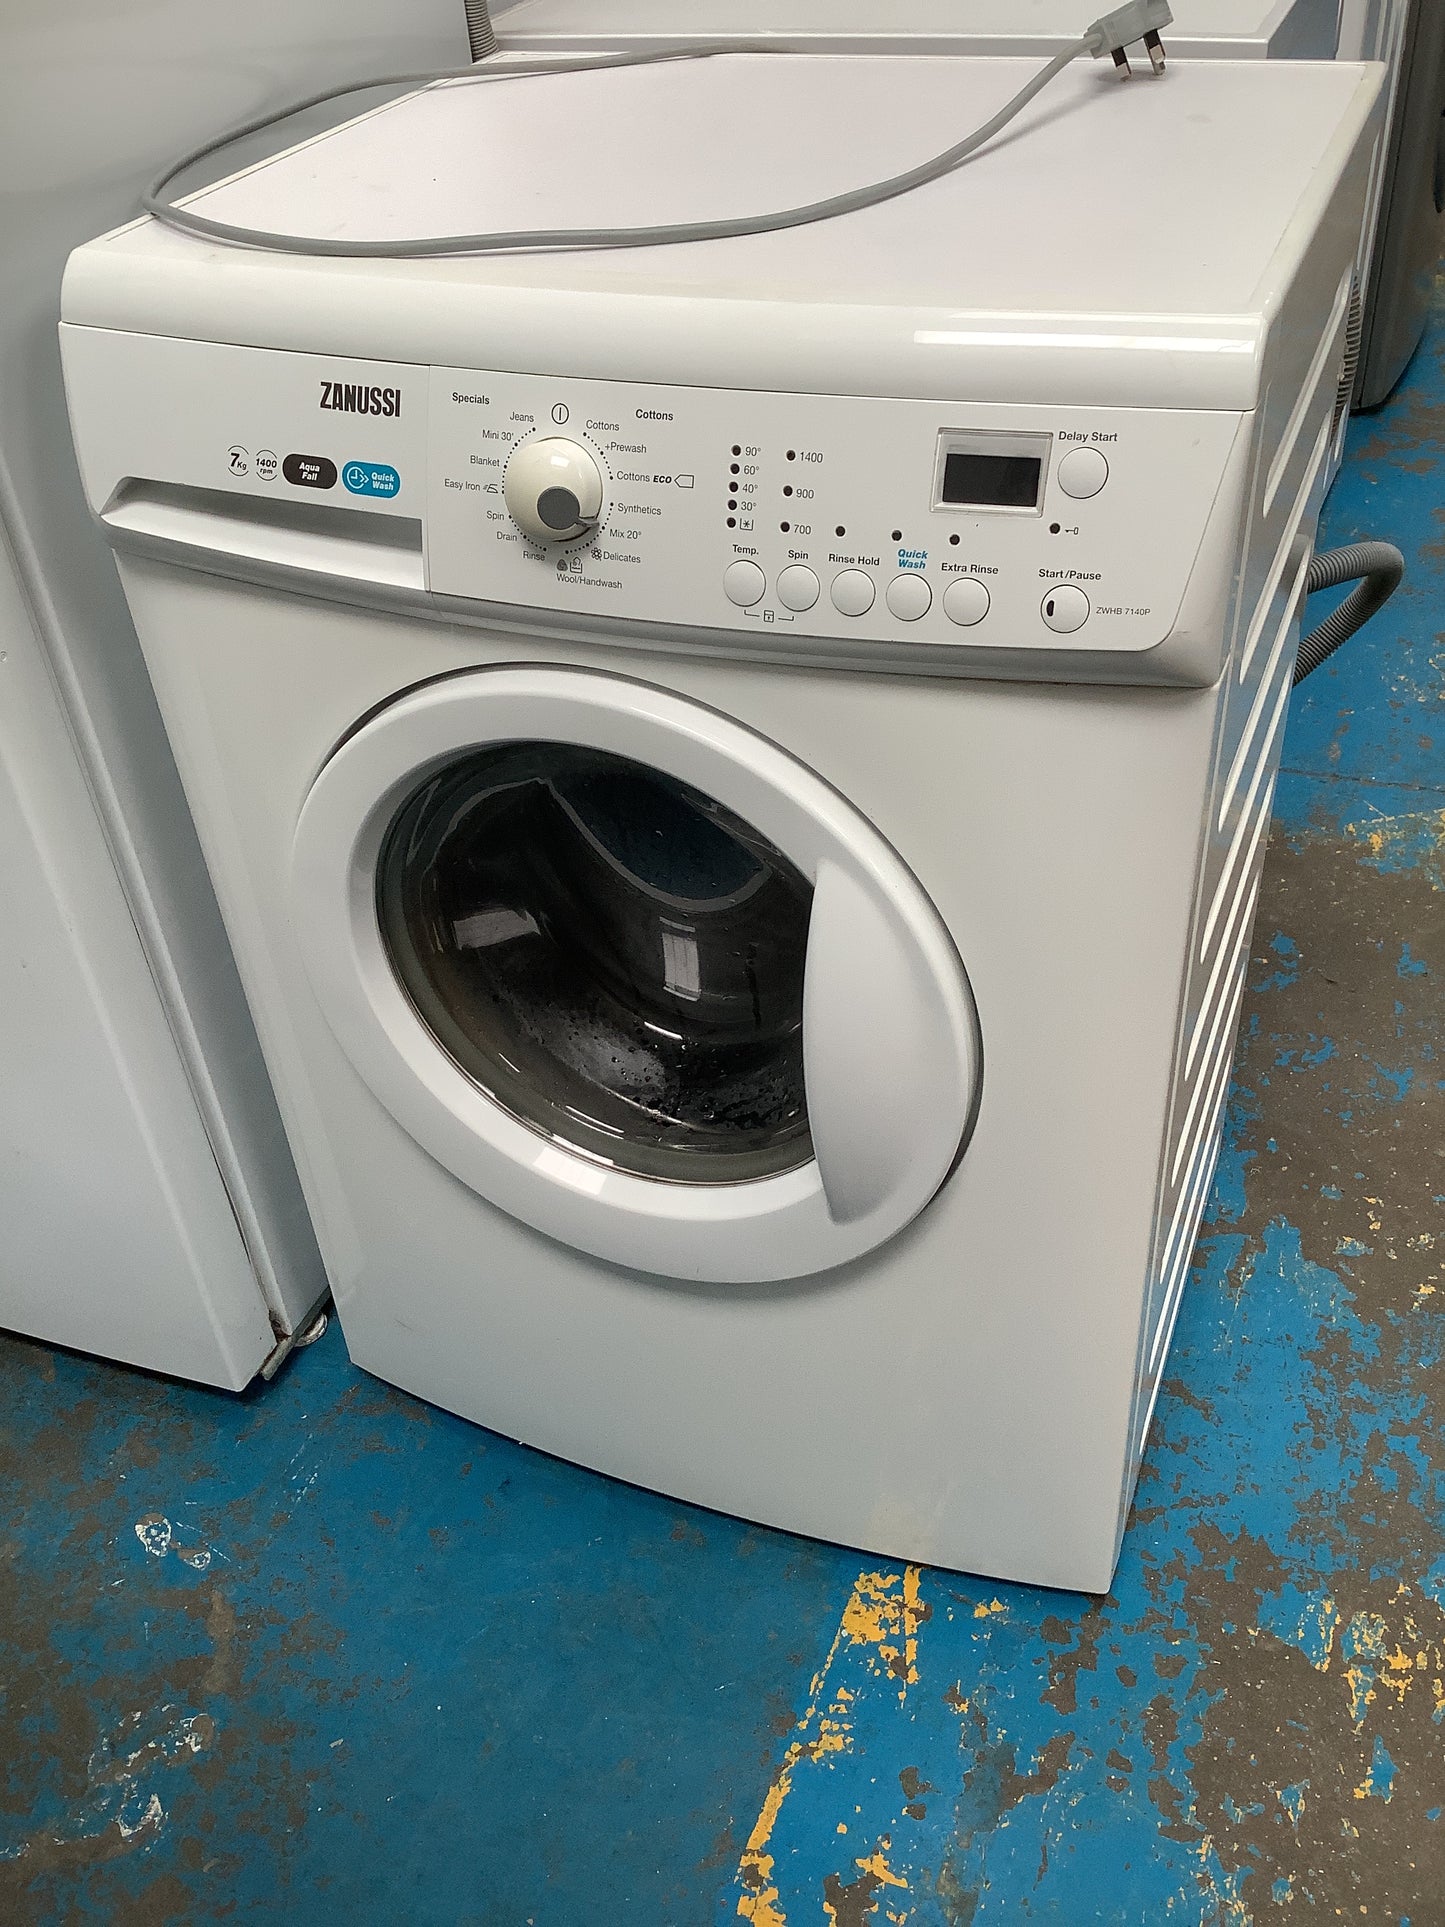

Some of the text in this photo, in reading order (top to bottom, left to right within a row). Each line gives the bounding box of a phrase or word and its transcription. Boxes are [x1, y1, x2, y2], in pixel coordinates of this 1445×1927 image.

[320, 381, 401, 417] ZANUSSI
[452, 392, 490, 405] Specials
[509, 411, 535, 422] Jeans
[635, 408, 674, 421] Cottons
[585, 420, 620, 431] Cottons
[482, 429, 499, 440] Mini
[1058, 431, 1118, 443] Delay Start
[255, 457, 278, 469] 1400
[470, 454, 500, 467] Blanket
[799, 451, 824, 463] 1400
[259, 467, 273, 475] rpm
[298, 461, 320, 473] Aqua
[301, 471, 318, 481] Fall
[371, 471, 395, 482] Quick
[616, 470, 672, 484] Cottons ECO
[372, 480, 394, 491] Wash
[444, 478, 481, 491] Easy Iron
[796, 488, 815, 499] 900
[617, 502, 662, 516] Synthetics
[486, 510, 505, 521] Spin
[609, 529, 624, 538] Mix
[793, 524, 812, 535] 700
[496, 531, 518, 541] Drain
[522, 550, 546, 561] Rinse
[732, 543, 759, 556] Temp.
[788, 549, 809, 560] Spin
[897, 548, 928, 560] Quick
[603, 551, 641, 563] Delicates
[828, 553, 880, 566] Rinse Hold
[898, 559, 926, 569] Wash
[941, 562, 999, 575] Extra Rinse
[556, 573, 623, 589] Wool/Handwash
[1095, 606, 1151, 616] ZWHB 7140P
